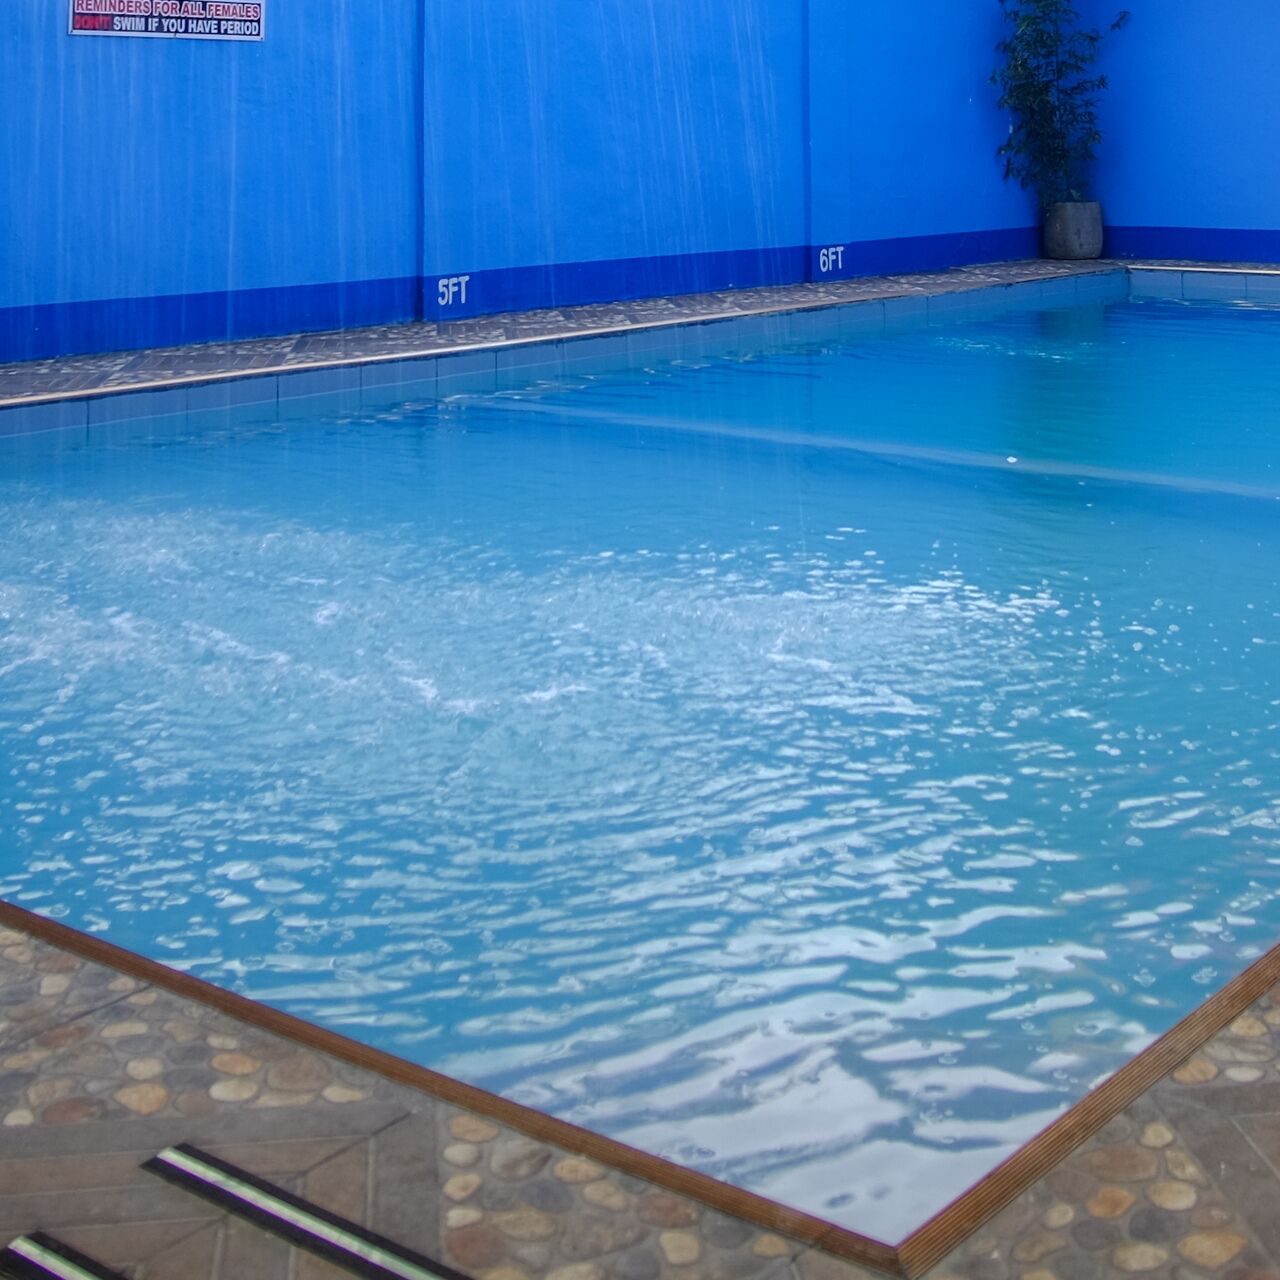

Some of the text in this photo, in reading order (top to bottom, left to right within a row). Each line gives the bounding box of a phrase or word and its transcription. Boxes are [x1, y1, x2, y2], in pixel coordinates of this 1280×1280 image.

[154, 1, 179, 15] FOR
[180, 3, 206, 17] ALL
[207, 4, 260, 18] FEMALES
[113, 17, 145, 30] SWIM
[148, 17, 159, 31] IF
[162, 18, 186, 32] YOU
[188, 19, 218, 34] HAVE
[220, 22, 259, 35] PERIOD
[820, 246, 844, 272] 6FT
[438, 275, 470, 305] 5FT
